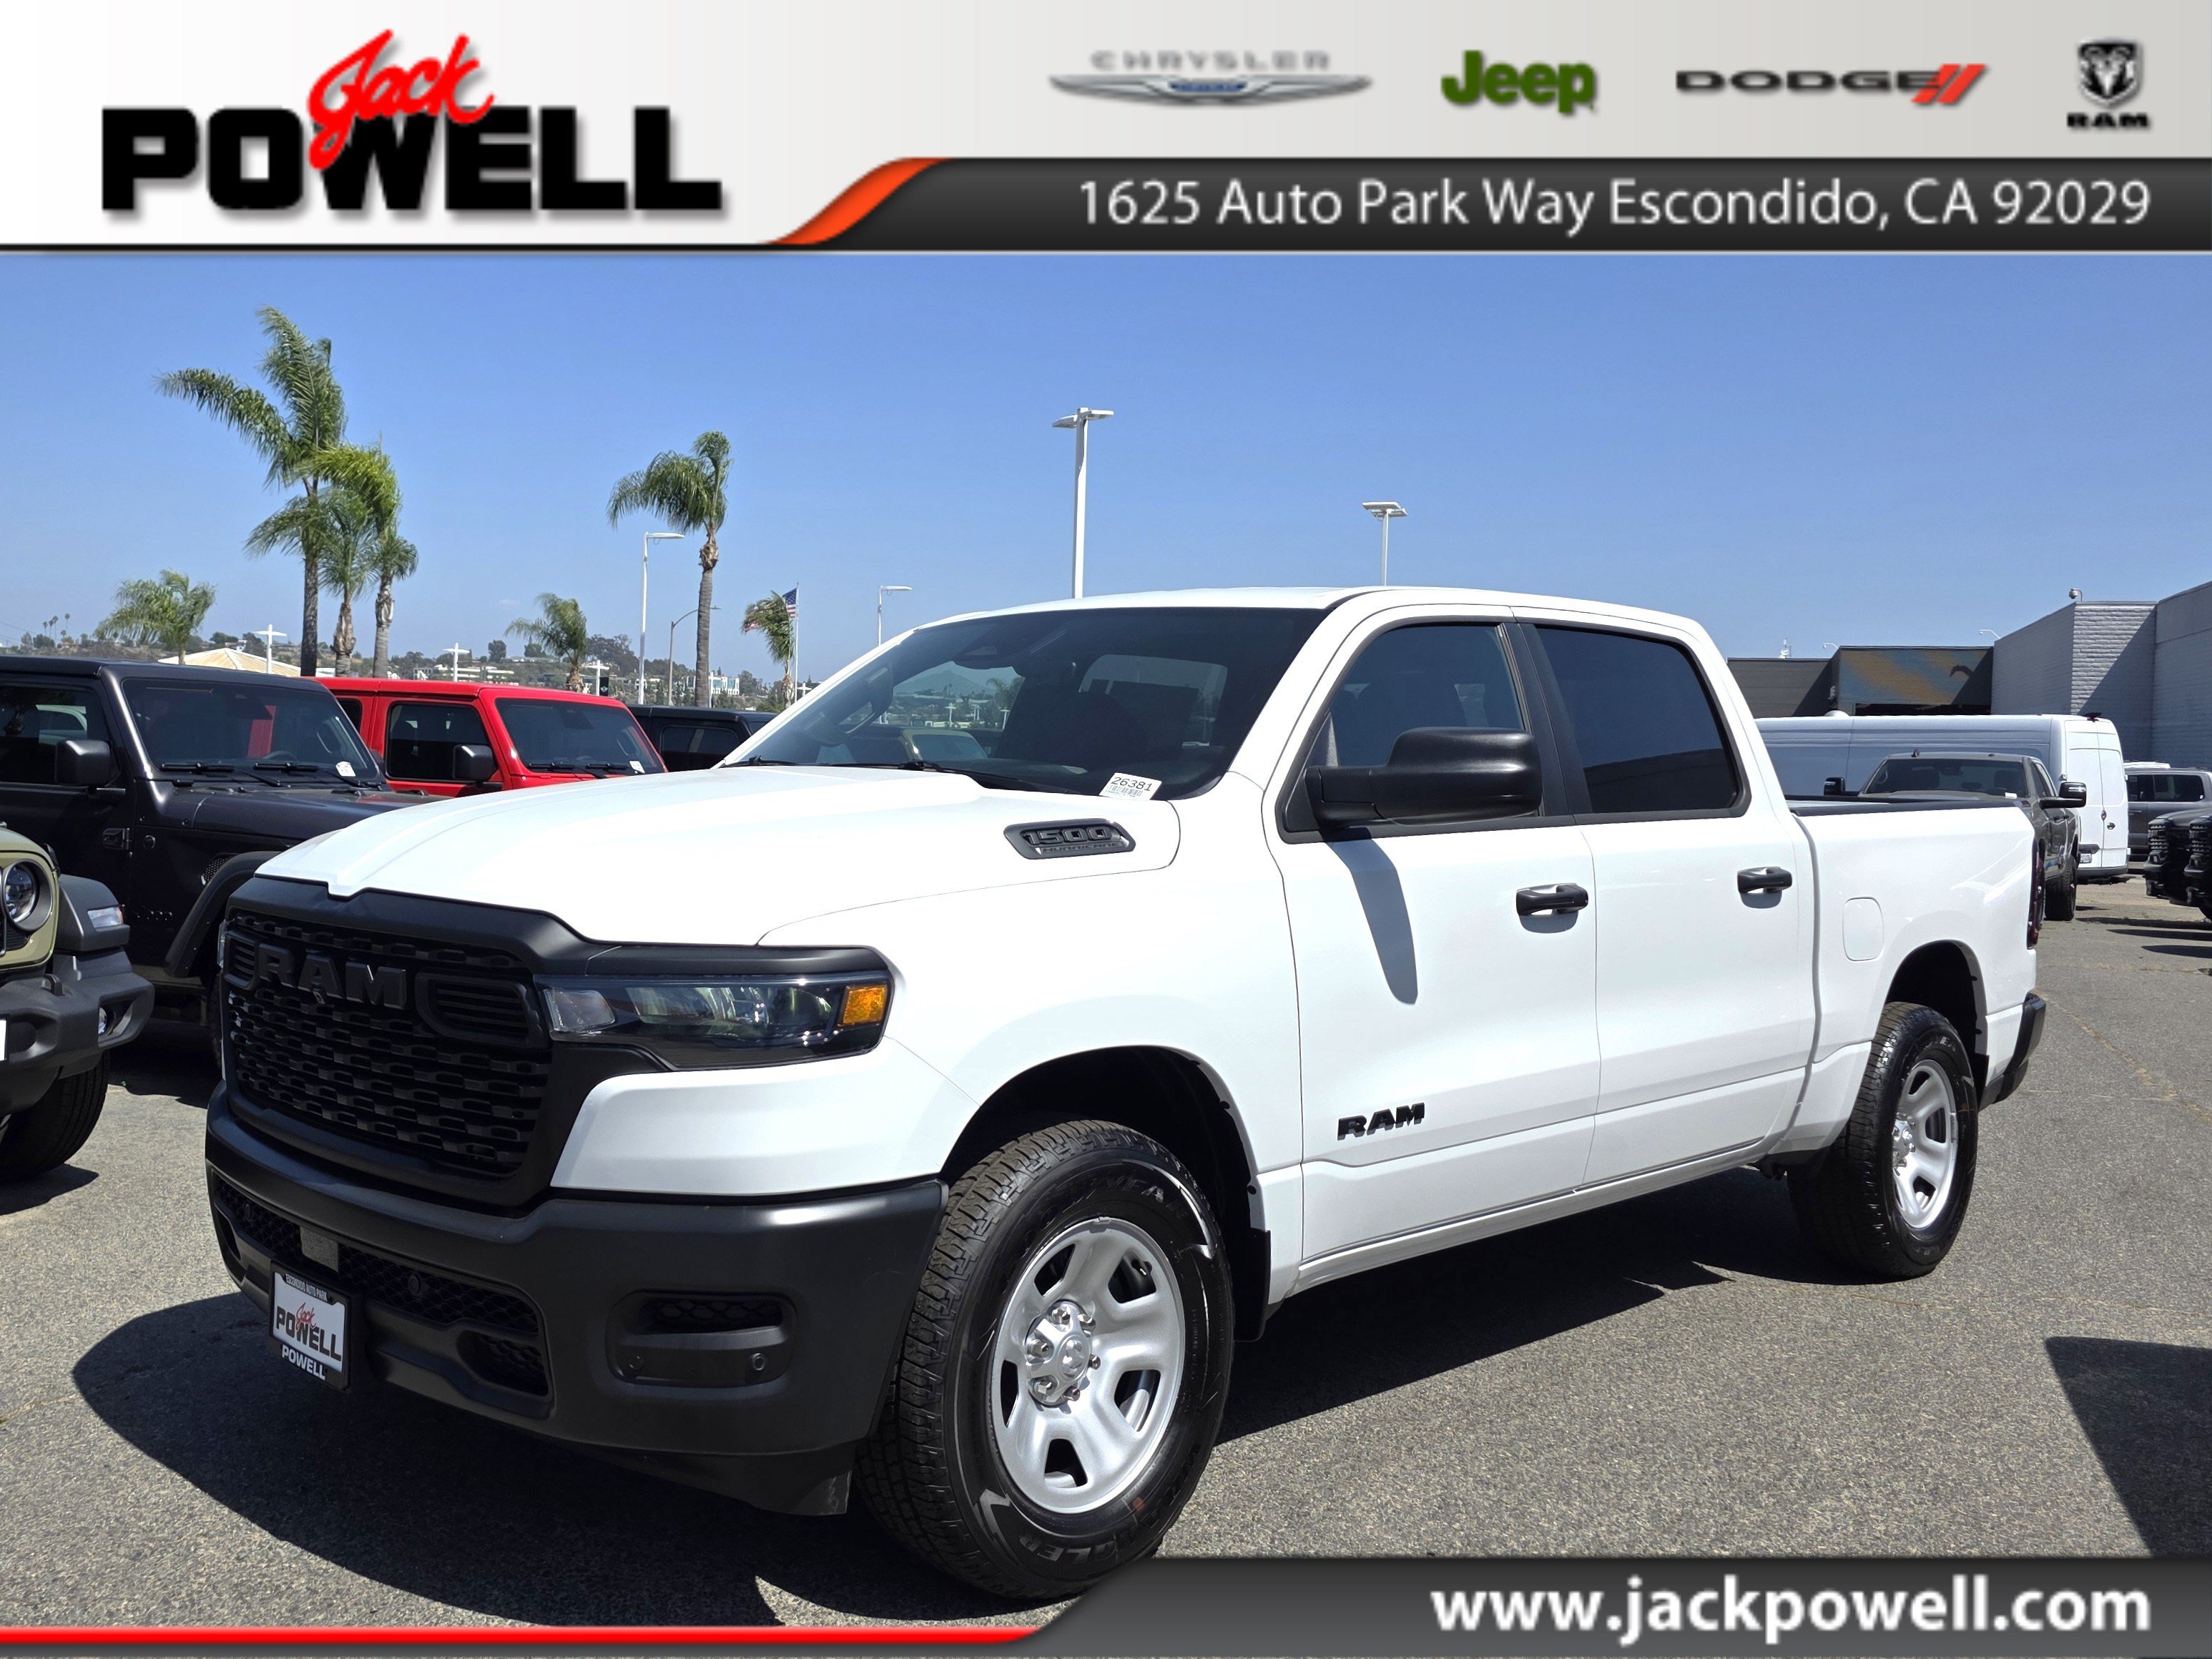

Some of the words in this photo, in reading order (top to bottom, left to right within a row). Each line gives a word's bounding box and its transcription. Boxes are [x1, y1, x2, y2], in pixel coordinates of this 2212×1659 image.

[1110, 777, 1153, 792] 26381
[1025, 827, 1111, 845] 1500
[258, 942, 408, 1009] RAM
[1337, 1102, 1425, 1138] RAM
[276, 1306, 342, 1362] POWELL
[295, 1302, 317, 1332] Jack
[282, 1344, 326, 1381] POWELL
